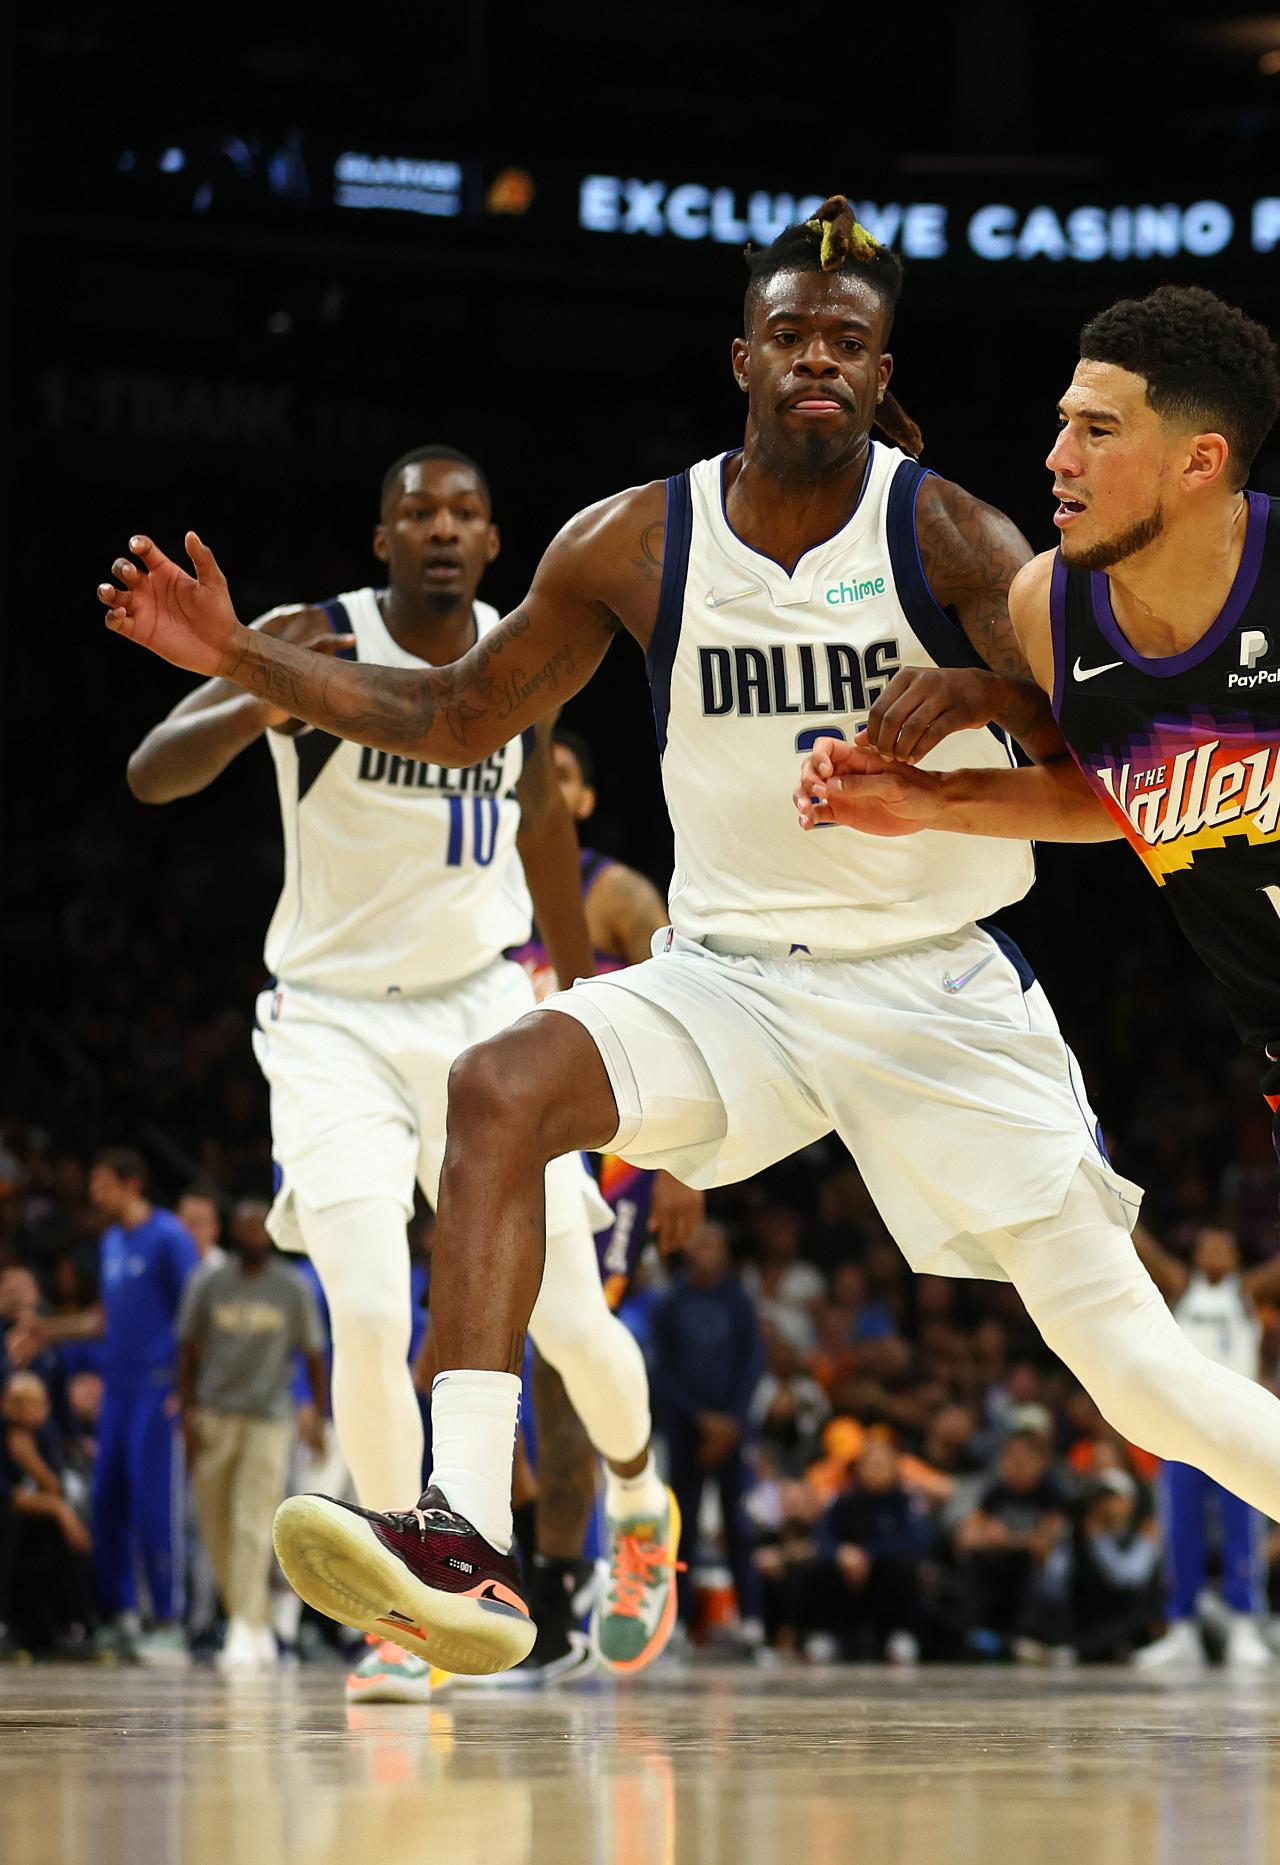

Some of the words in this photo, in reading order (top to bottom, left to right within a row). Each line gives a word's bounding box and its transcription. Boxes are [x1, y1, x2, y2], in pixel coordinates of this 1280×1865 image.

[580, 175, 948, 260] EXCLUVE
[967, 201, 1233, 262] CASINO
[826, 574, 886, 606] chime
[697, 638, 900, 718] DALLAS
[1228, 668, 1280, 688] PayPal
[1133, 765, 1167, 791] THE
[444, 793, 499, 867] 10
